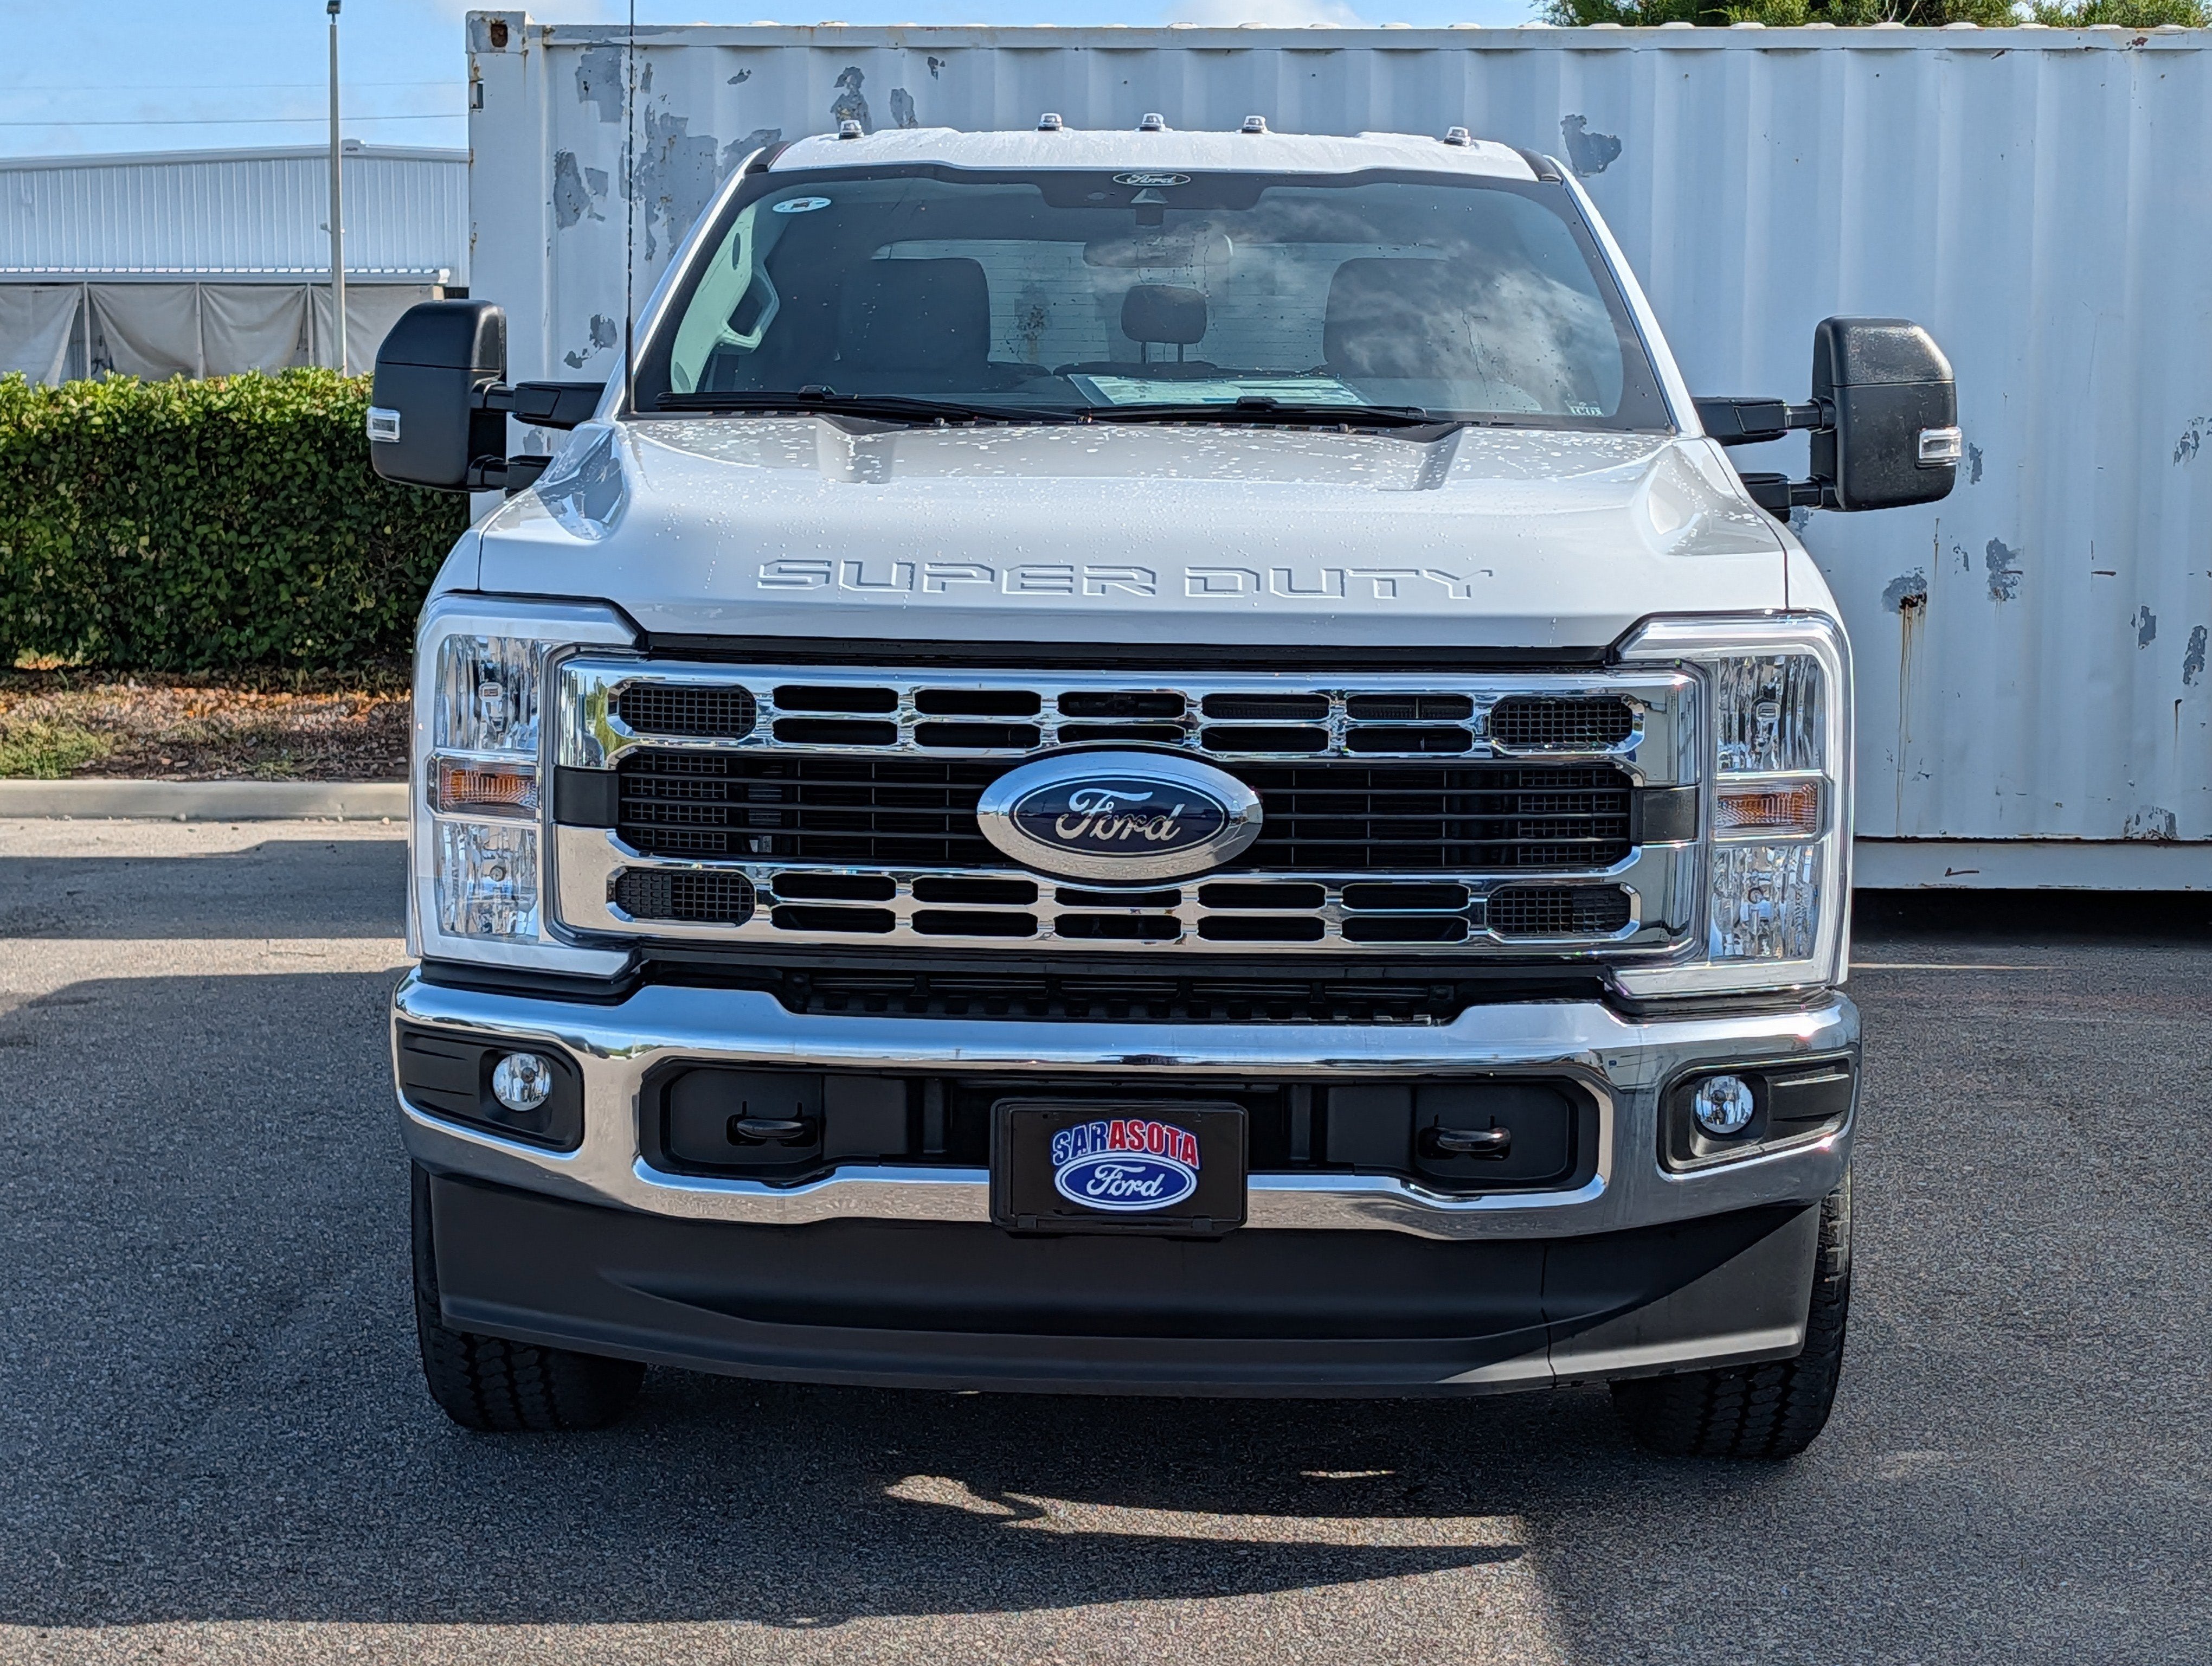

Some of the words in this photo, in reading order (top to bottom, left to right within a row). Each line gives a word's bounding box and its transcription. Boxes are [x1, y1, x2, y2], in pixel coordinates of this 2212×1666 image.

[757, 559, 1157, 597] SUPER
[1185, 567, 1493, 599] DUTY
[1055, 787, 1186, 841] Ford
[1052, 1119, 1200, 1170] SARASOTA
[1086, 1164, 1165, 1197] Ford
